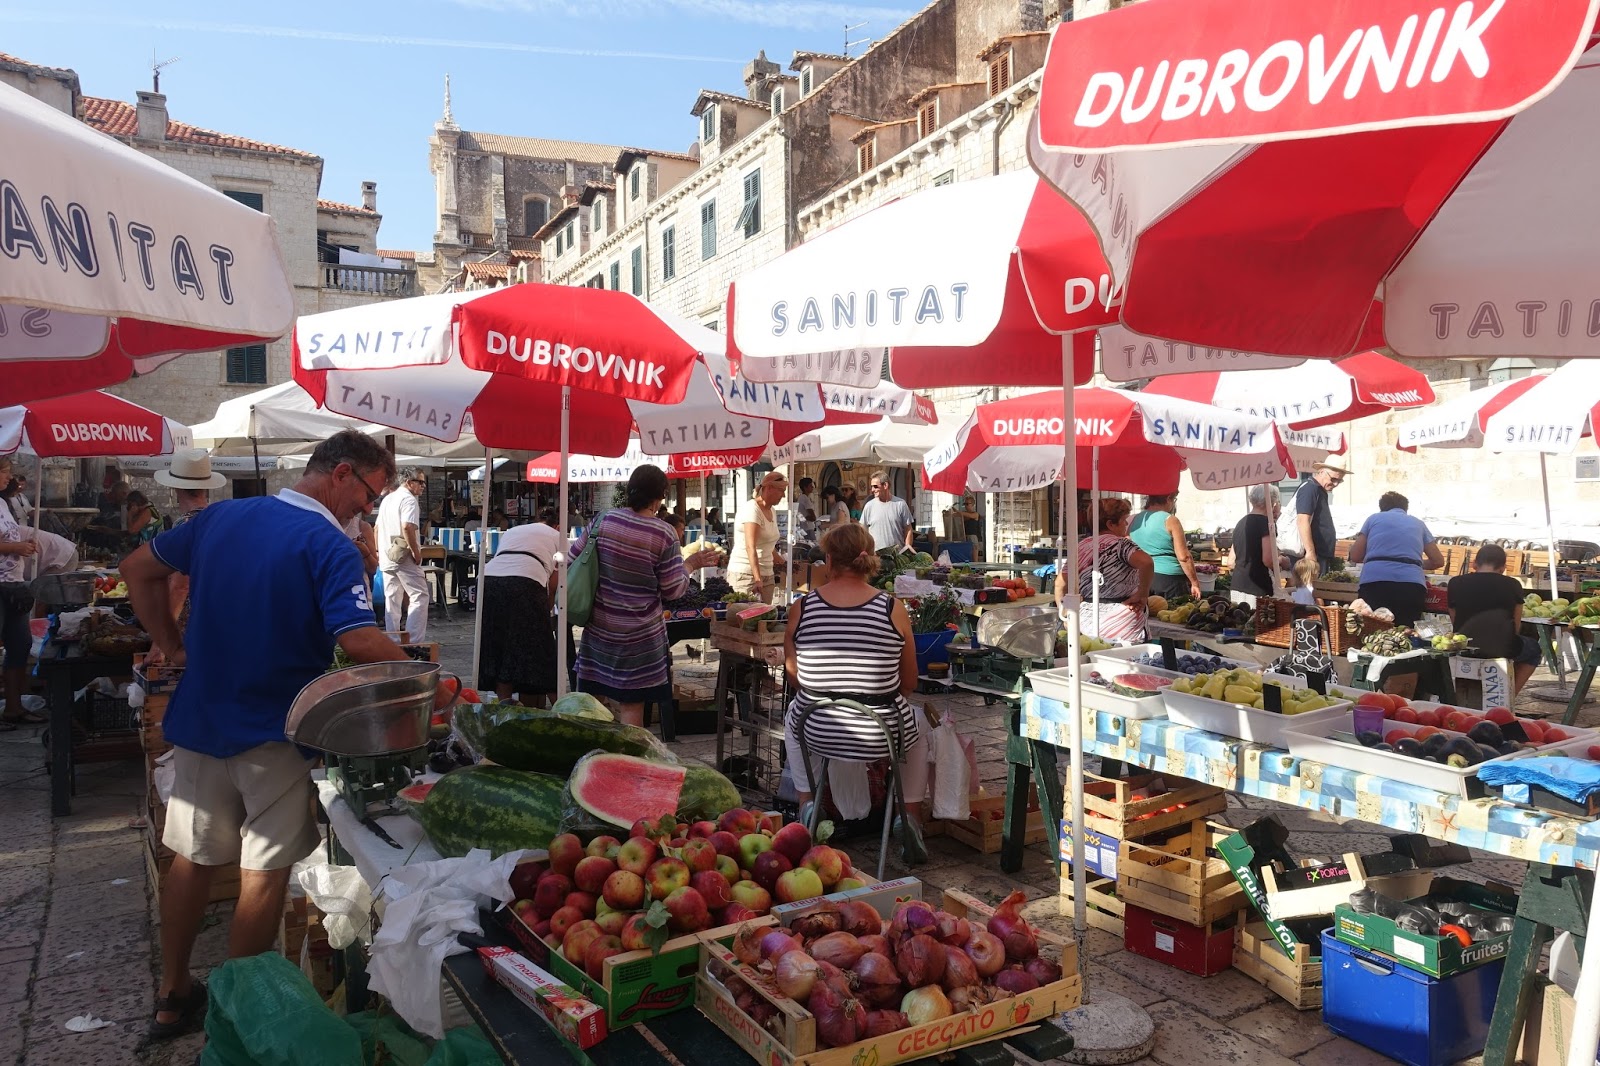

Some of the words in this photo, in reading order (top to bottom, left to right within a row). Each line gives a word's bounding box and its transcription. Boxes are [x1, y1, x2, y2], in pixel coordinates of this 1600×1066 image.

[1073, 0, 1503, 128] DUBROVNIK
[0, 179, 234, 305] ANITAT
[771, 282, 969, 337] SANITAT
[486, 330, 666, 389] DUBROVNIK
[715, 374, 804, 412] SANITAT
[51, 422, 153, 442] DUBROVNIK
[993, 417, 1114, 437] DUBRONIK
[1153, 418, 1257, 447] SANITAT
[1283, 430, 1331, 446] SANITAT
[1409, 421, 1466, 440] SANITAT
[1505, 424, 1574, 444] SANITAT
[683, 454, 754, 468] DUBROVNIK
[773, 442, 812, 462] SANTAT
[571, 467, 631, 478] SANITAT
[1275, 924, 1295, 954] fon
[1460, 940, 1504, 965] fruites
[715, 995, 761, 1046] CECCATO
[897, 1009, 995, 1055] CECCATO
